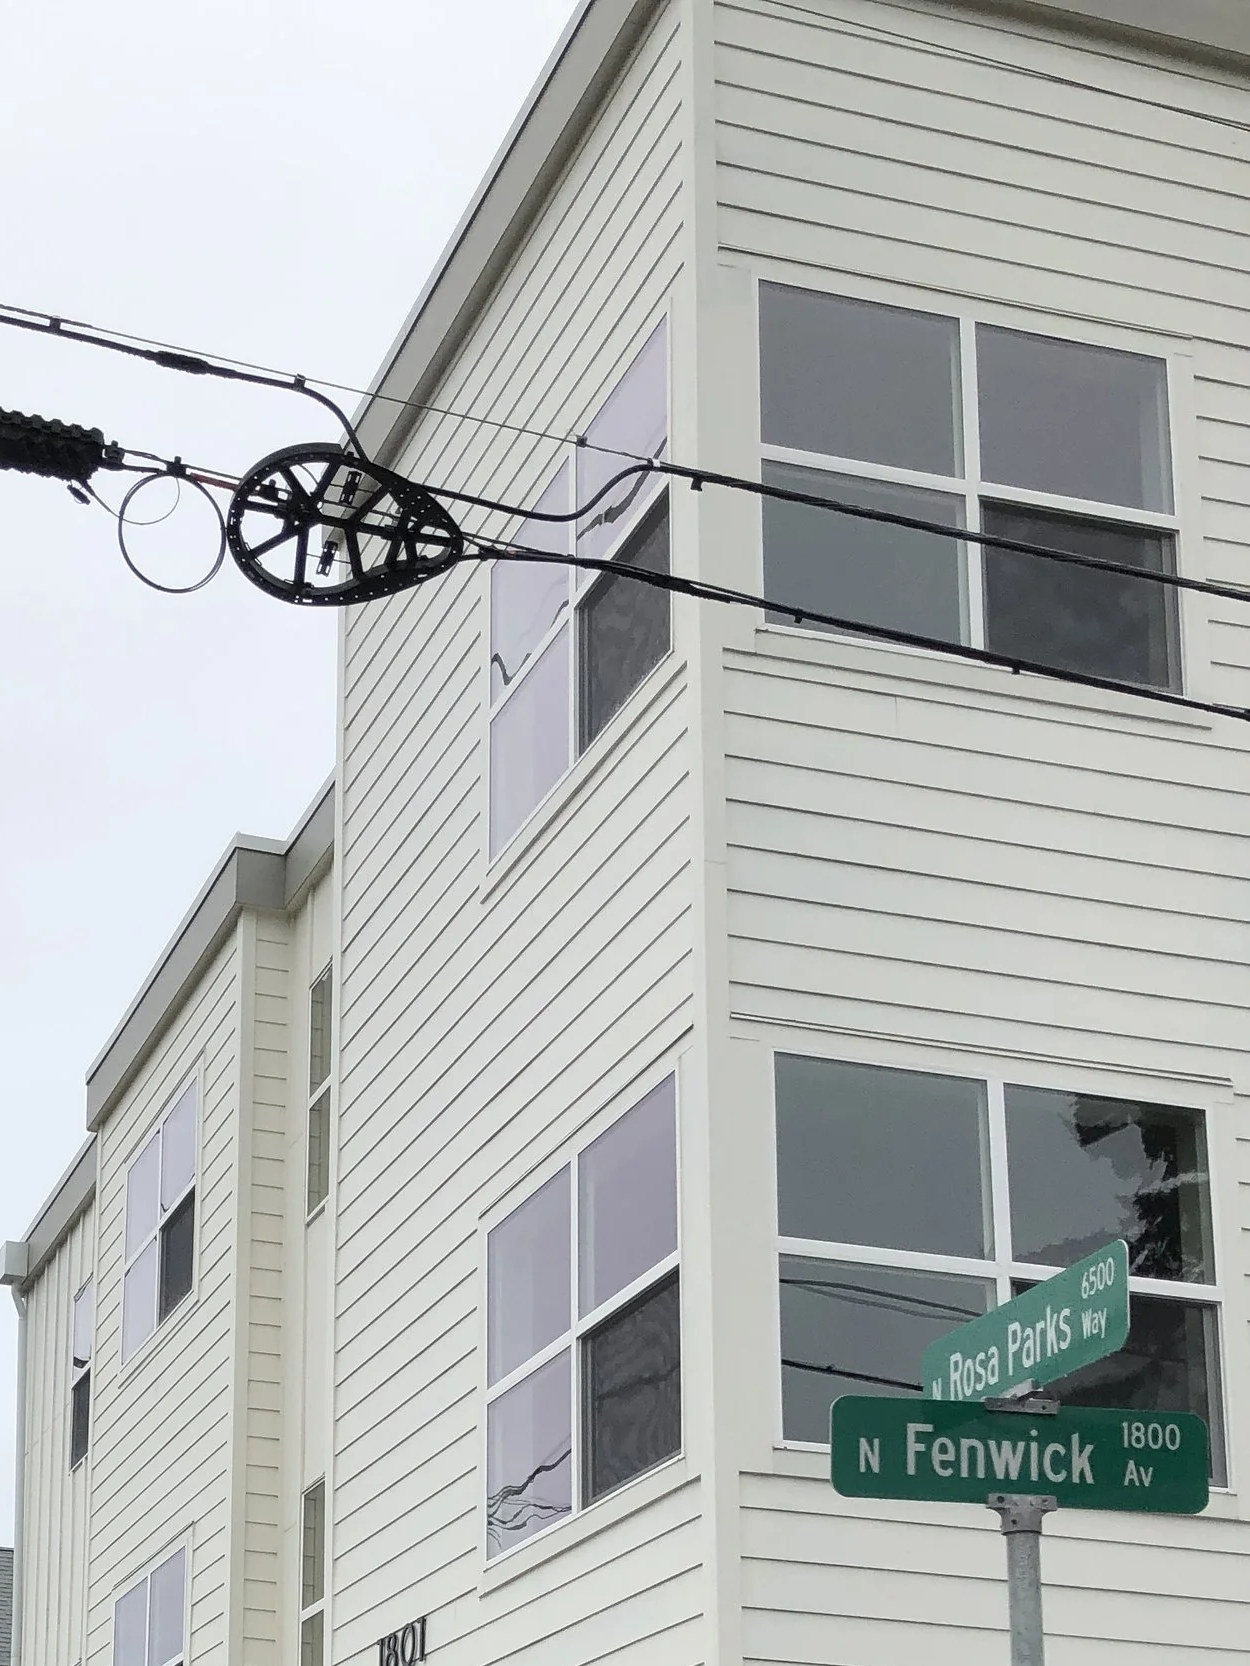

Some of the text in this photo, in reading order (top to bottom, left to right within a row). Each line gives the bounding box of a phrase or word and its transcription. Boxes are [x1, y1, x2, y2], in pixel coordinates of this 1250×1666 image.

[1081, 1257, 1114, 1300] 6500
[932, 1306, 1108, 1400] N Rosa Parks Way
[859, 1422, 1153, 1487] N Fenwick Av
[1122, 1421, 1181, 1451] 1800
